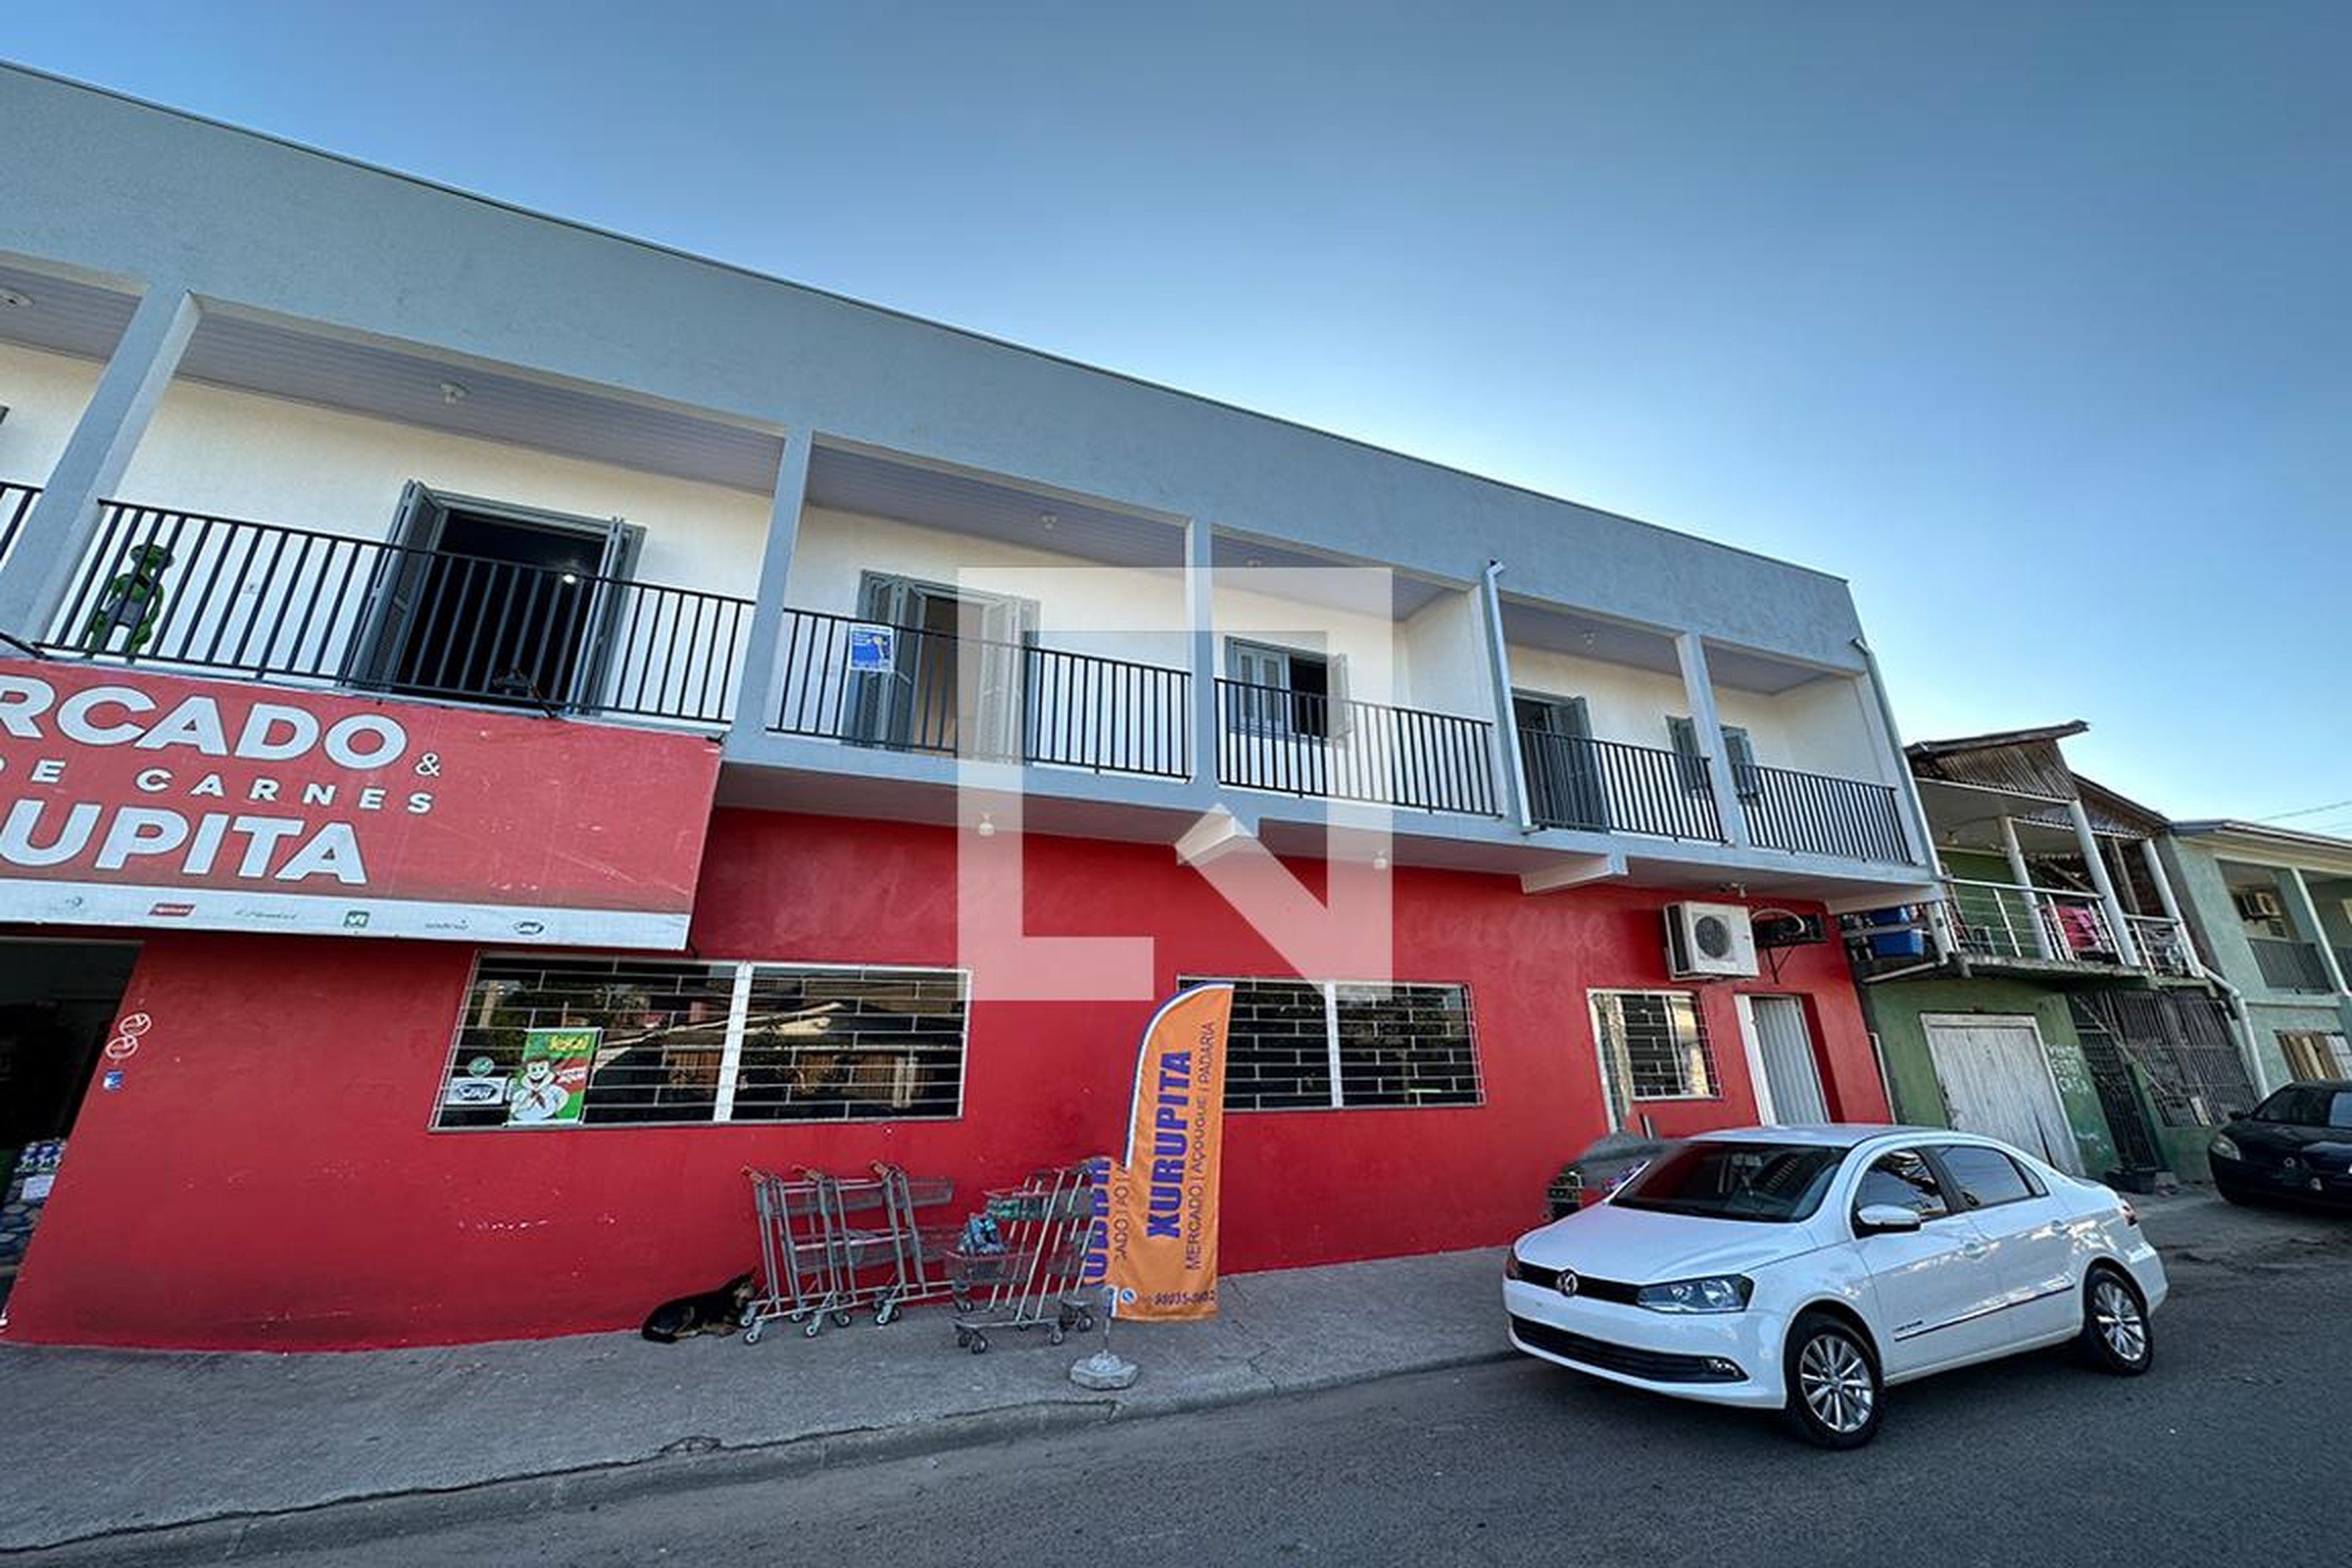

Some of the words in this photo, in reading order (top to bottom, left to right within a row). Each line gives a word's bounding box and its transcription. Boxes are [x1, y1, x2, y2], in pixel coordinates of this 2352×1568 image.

[0, 755, 66, 783] E
[135, 768, 433, 814] CARNES
[415, 753, 440, 777] &
[0, 799, 367, 884] UPITA
[1147, 1051, 1191, 1238] XURUPITA
[1185, 1185, 1204, 1270] MERCADO
[1198, 1022, 1215, 1084] PADARIA
